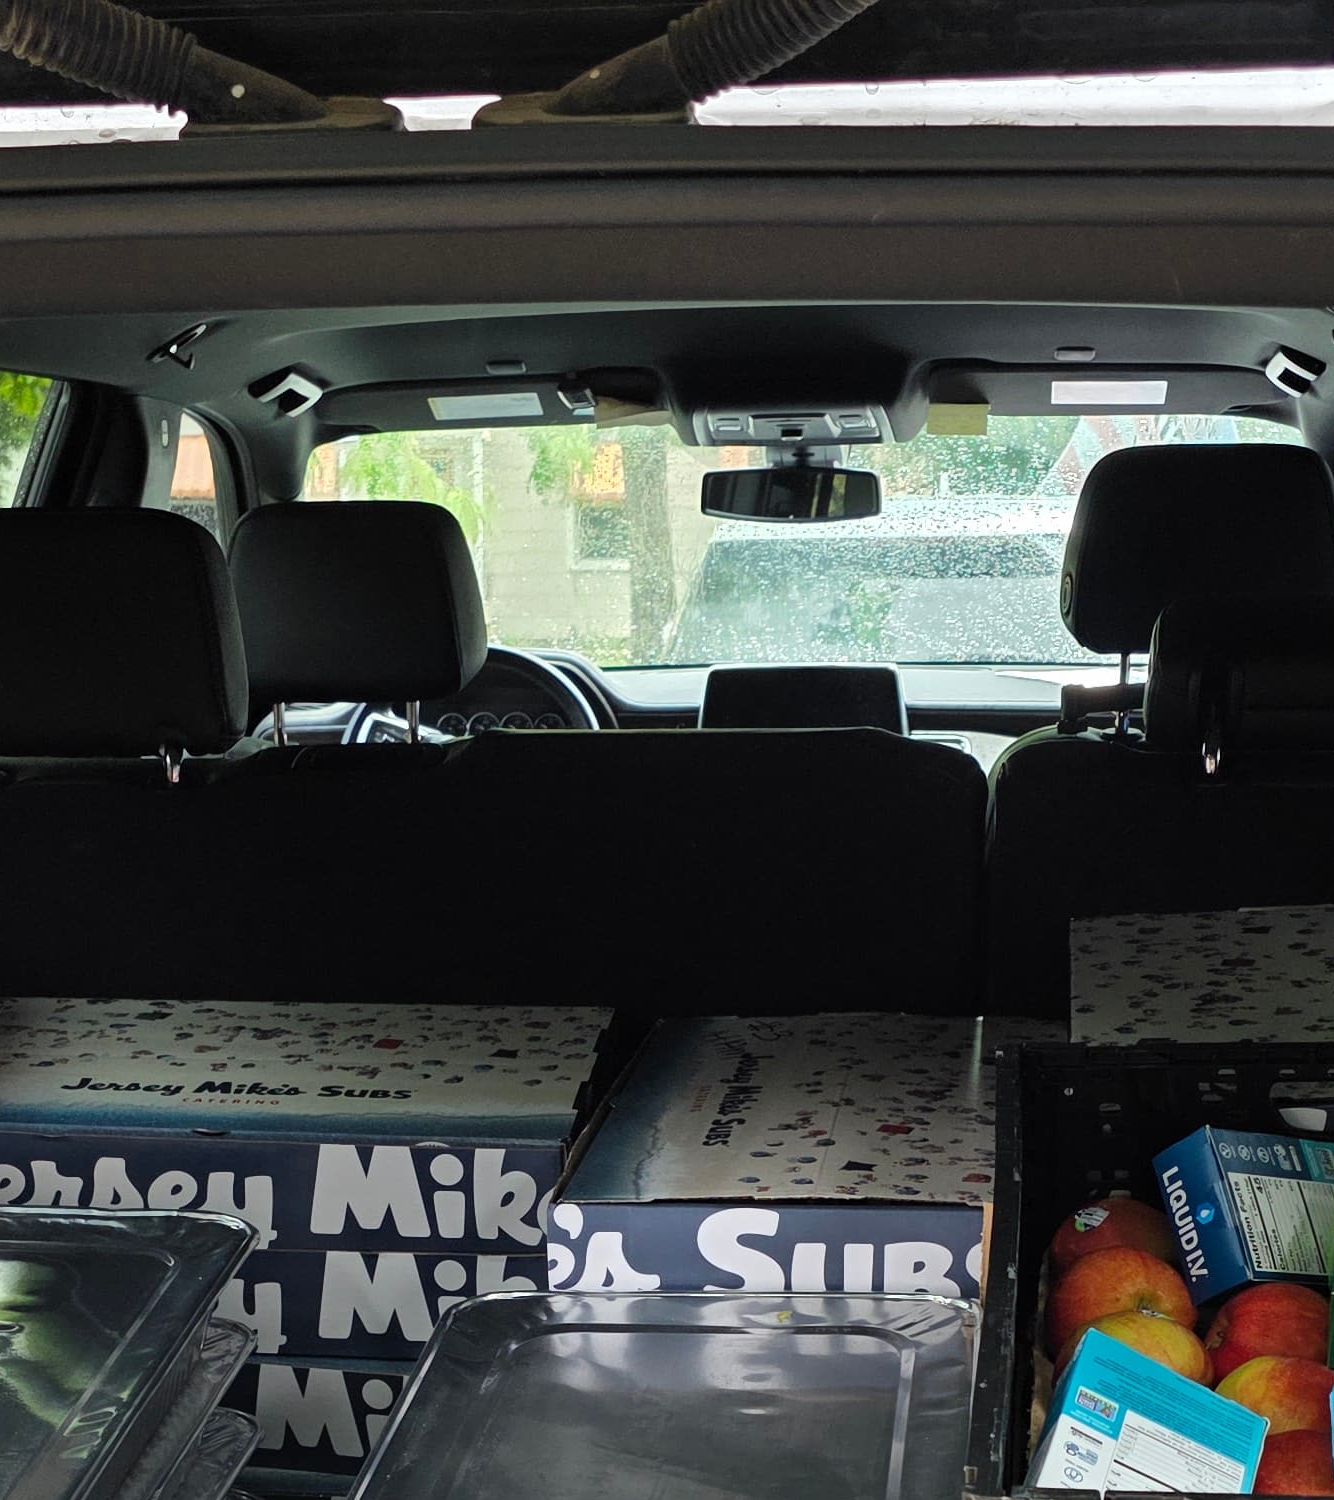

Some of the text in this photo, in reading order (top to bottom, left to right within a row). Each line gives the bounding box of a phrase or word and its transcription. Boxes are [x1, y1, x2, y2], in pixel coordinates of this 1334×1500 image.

[60, 1077, 413, 1100] Jersey Mike's SUBS
[309, 1143, 553, 1246] Mik
[1162, 1165, 1200, 1252] LIQUID
[1234, 1180, 1264, 1270] Nutrition Facts
[697, 1207, 983, 1293] SUB
